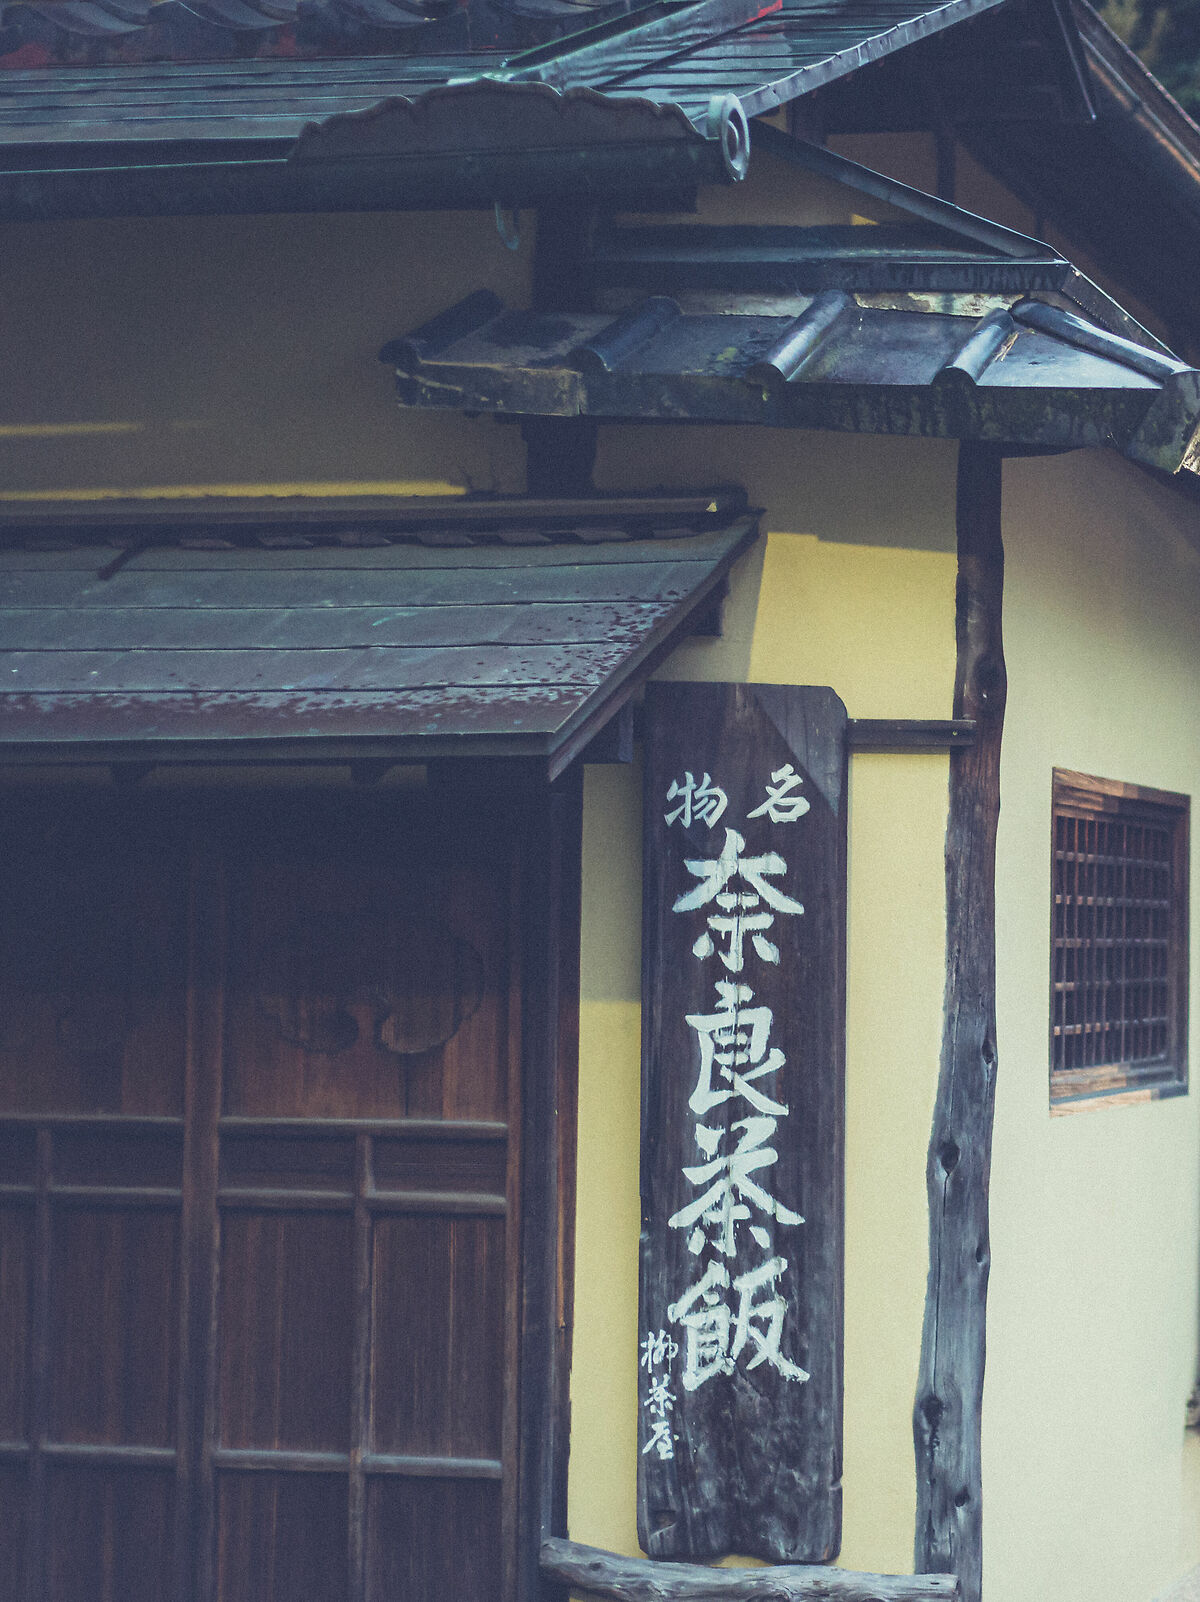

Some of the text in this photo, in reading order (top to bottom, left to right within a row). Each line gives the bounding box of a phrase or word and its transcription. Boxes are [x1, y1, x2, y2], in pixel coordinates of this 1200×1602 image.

[664, 764, 810, 828] 名物
[668, 827, 810, 1391] 奈良茶飯
